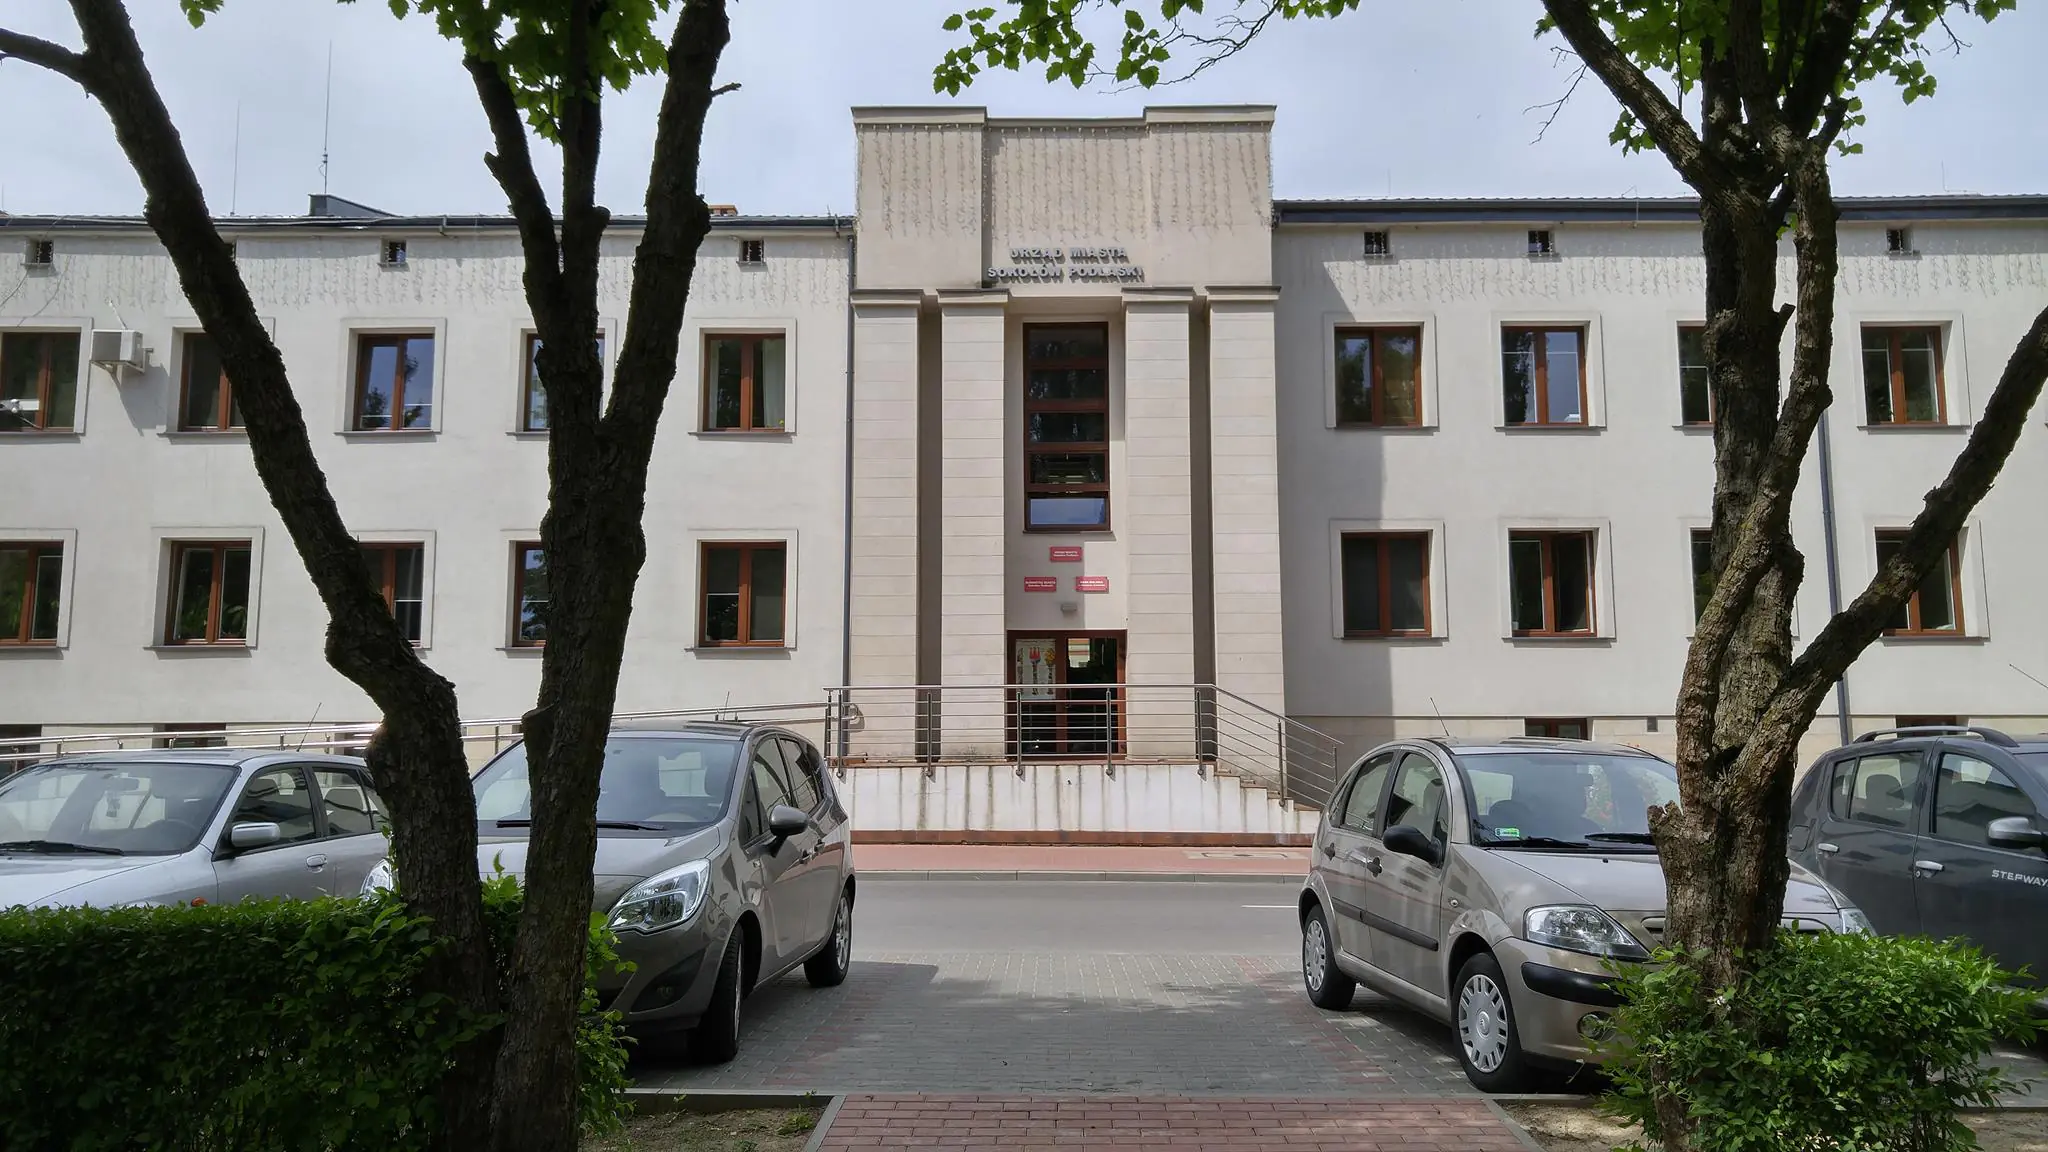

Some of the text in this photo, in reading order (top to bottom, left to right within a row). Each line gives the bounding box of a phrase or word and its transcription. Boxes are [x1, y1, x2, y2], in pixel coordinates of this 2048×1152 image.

[1010, 247, 1128, 261] URZĄD MIASTA
[1068, 266, 1144, 278] PODLASKI
[1991, 869, 2048, 886] STEPWAY
